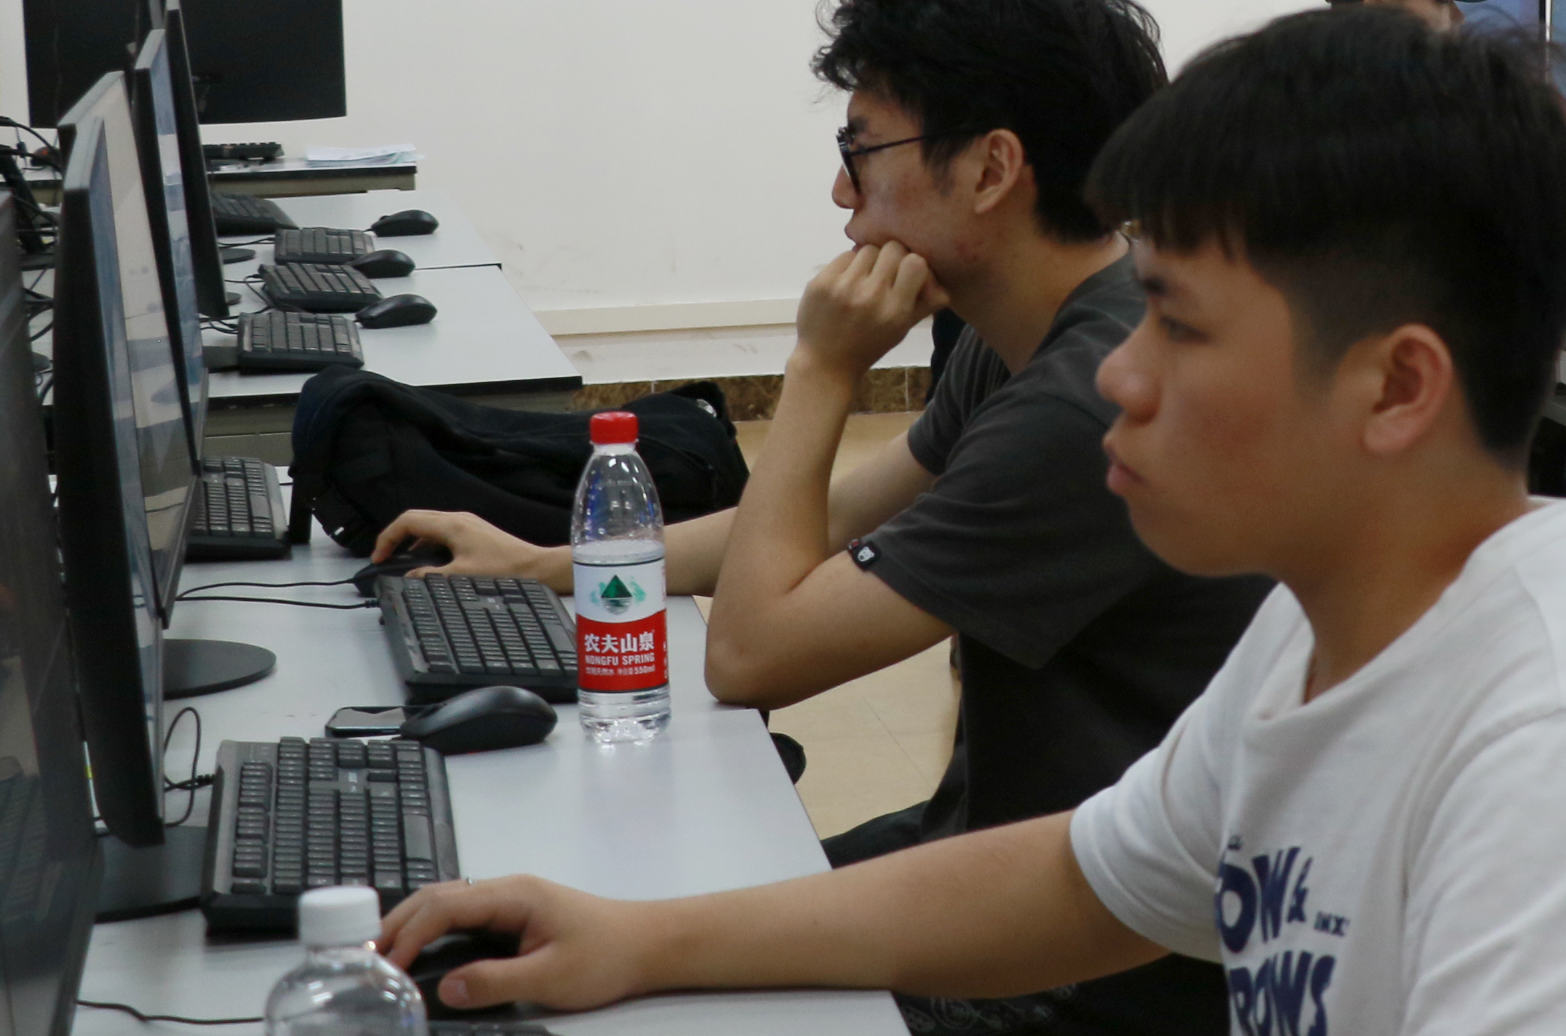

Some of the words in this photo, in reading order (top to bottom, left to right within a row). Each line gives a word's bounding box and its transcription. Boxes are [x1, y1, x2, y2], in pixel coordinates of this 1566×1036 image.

[584, 631, 655, 654] 农夫山泉
[585, 654, 619, 666] NONGFU
[622, 652, 655, 666] SPRING
